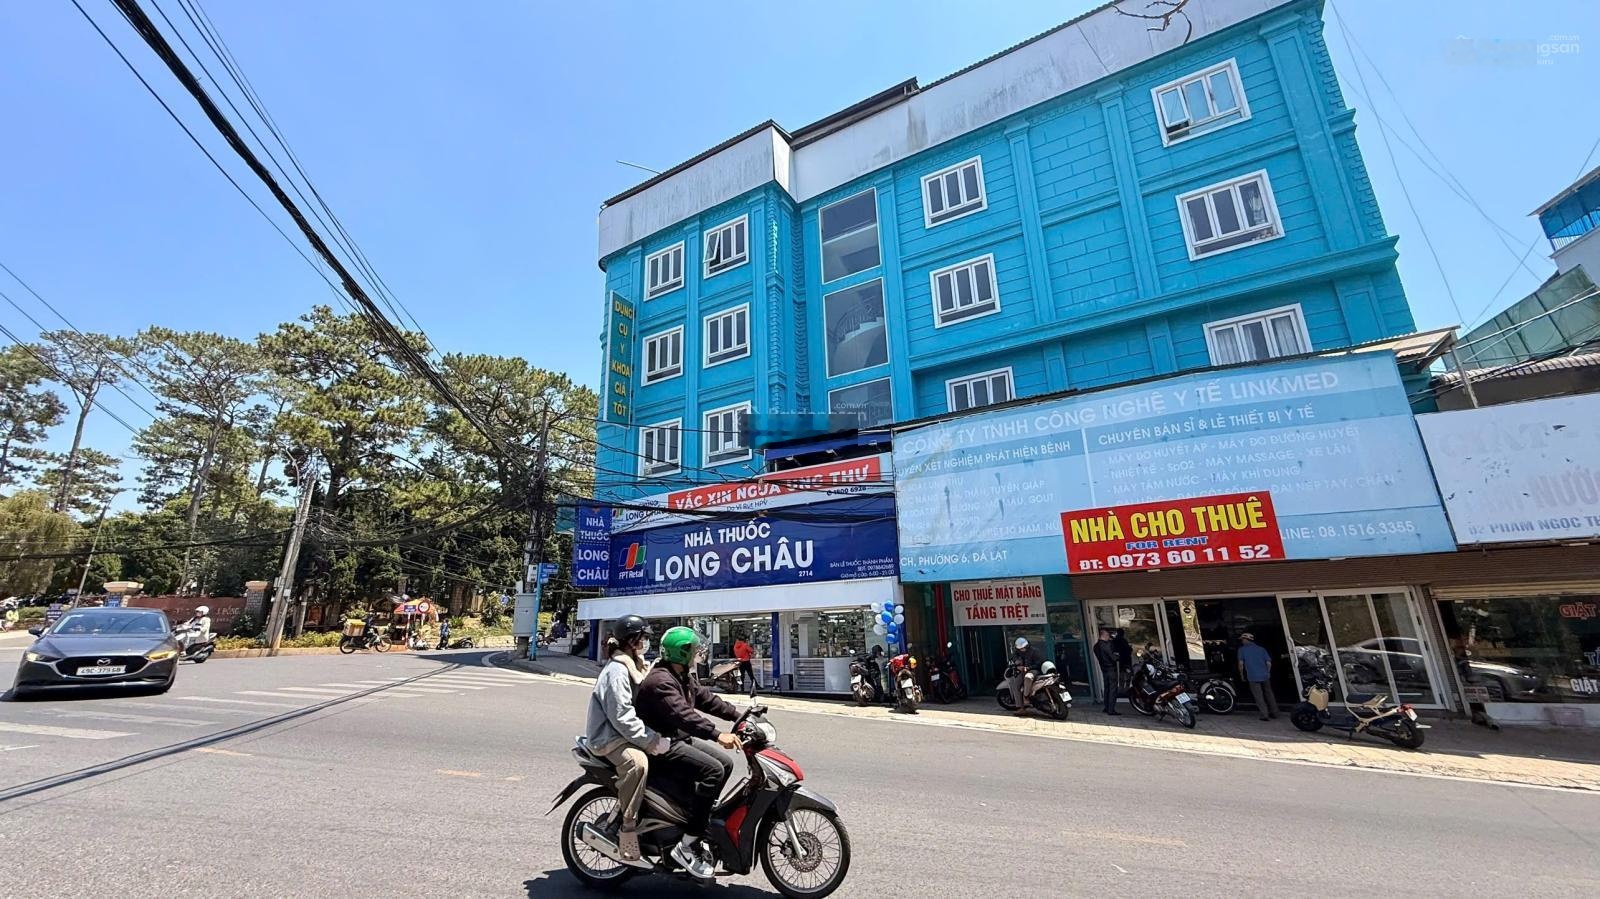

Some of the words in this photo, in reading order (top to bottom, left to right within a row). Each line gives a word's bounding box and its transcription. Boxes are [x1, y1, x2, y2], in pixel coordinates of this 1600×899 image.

[620, 342, 625, 354] Y
[611, 359, 631, 378] KHOA
[904, 430, 952, 454] CÔNG
[956, 428, 975, 445] TY
[983, 419, 1030, 442] TNHH
[1034, 405, 1097, 431] CÔNG
[1102, 391, 1167, 421] NGHỆ
[1174, 389, 1187, 409] Y
[1197, 378, 1223, 404] TẾ
[1230, 370, 1340, 401] LINKMED
[1097, 424, 1151, 446] CHUYÊN
[1154, 418, 1181, 438] BÁN
[1198, 418, 1209, 431] &
[1228, 407, 1264, 427] THIẾT
[1269, 409, 1281, 424] BỊ
[1285, 408, 1295, 421] Y
[1296, 403, 1315, 420] TẾ
[1236, 449, 1296, 465] MASSAGE
[675, 491, 703, 510] VẮC
[707, 486, 733, 507] XIN
[829, 463, 869, 484] THƯ
[585, 515, 605, 528] NHÀ
[1070, 510, 1125, 544] NHÀ
[1130, 508, 1186, 539] CHO
[1191, 495, 1267, 534] THUÊ
[580, 529, 610, 542] THUỐC
[684, 526, 714, 549] NHÀ
[718, 516, 771, 544] THUỐC
[1126, 540, 1158, 551] FOR
[1163, 536, 1209, 548] RENT
[578, 548, 610, 562] LONG
[654, 550, 721, 583] LONG
[731, 535, 814, 573] CHÂU
[1079, 559, 1103, 571] ĐT:
[1107, 552, 1161, 570] 0973
[1167, 549, 1196, 565] 60
[1203, 546, 1230, 562] 11
[1239, 544, 1271, 560] 52
[577, 566, 610, 581] CHÂU
[798, 569, 814, 577] 2714
[953, 589, 971, 602] CHO
[972, 585, 994, 601] THUÊ
[995, 585, 1014, 602] MẶT
[1016, 581, 1042, 599] BẰNG
[999, 602, 1030, 621] TRỆT
[1570, 675, 1600, 695] GIẶT
